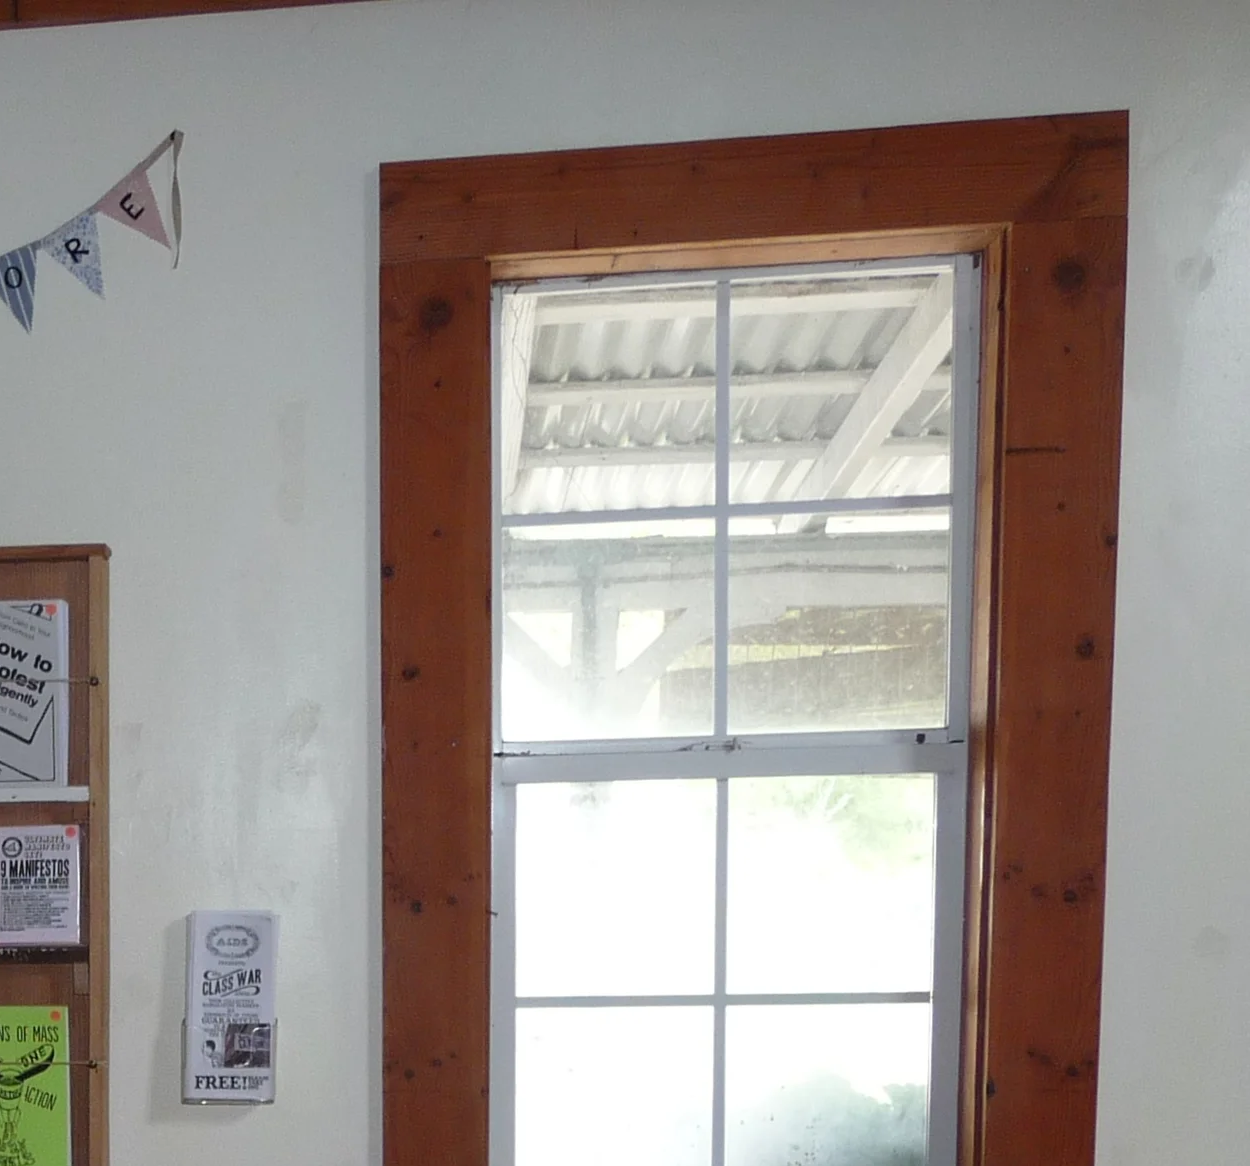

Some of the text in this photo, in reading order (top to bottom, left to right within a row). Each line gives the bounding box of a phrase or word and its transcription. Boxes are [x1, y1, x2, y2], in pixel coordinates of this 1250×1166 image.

[33, 654, 53, 673] to
[0, 859, 70, 878] 9 MANIFESTOS
[202, 968, 261, 996] CLASS WAR
[16, 1026, 28, 1042] OF
[33, 1026, 59, 1043] MASS
[20, 1045, 46, 1068] ONE
[194, 1075, 247, 1090] FREE!
